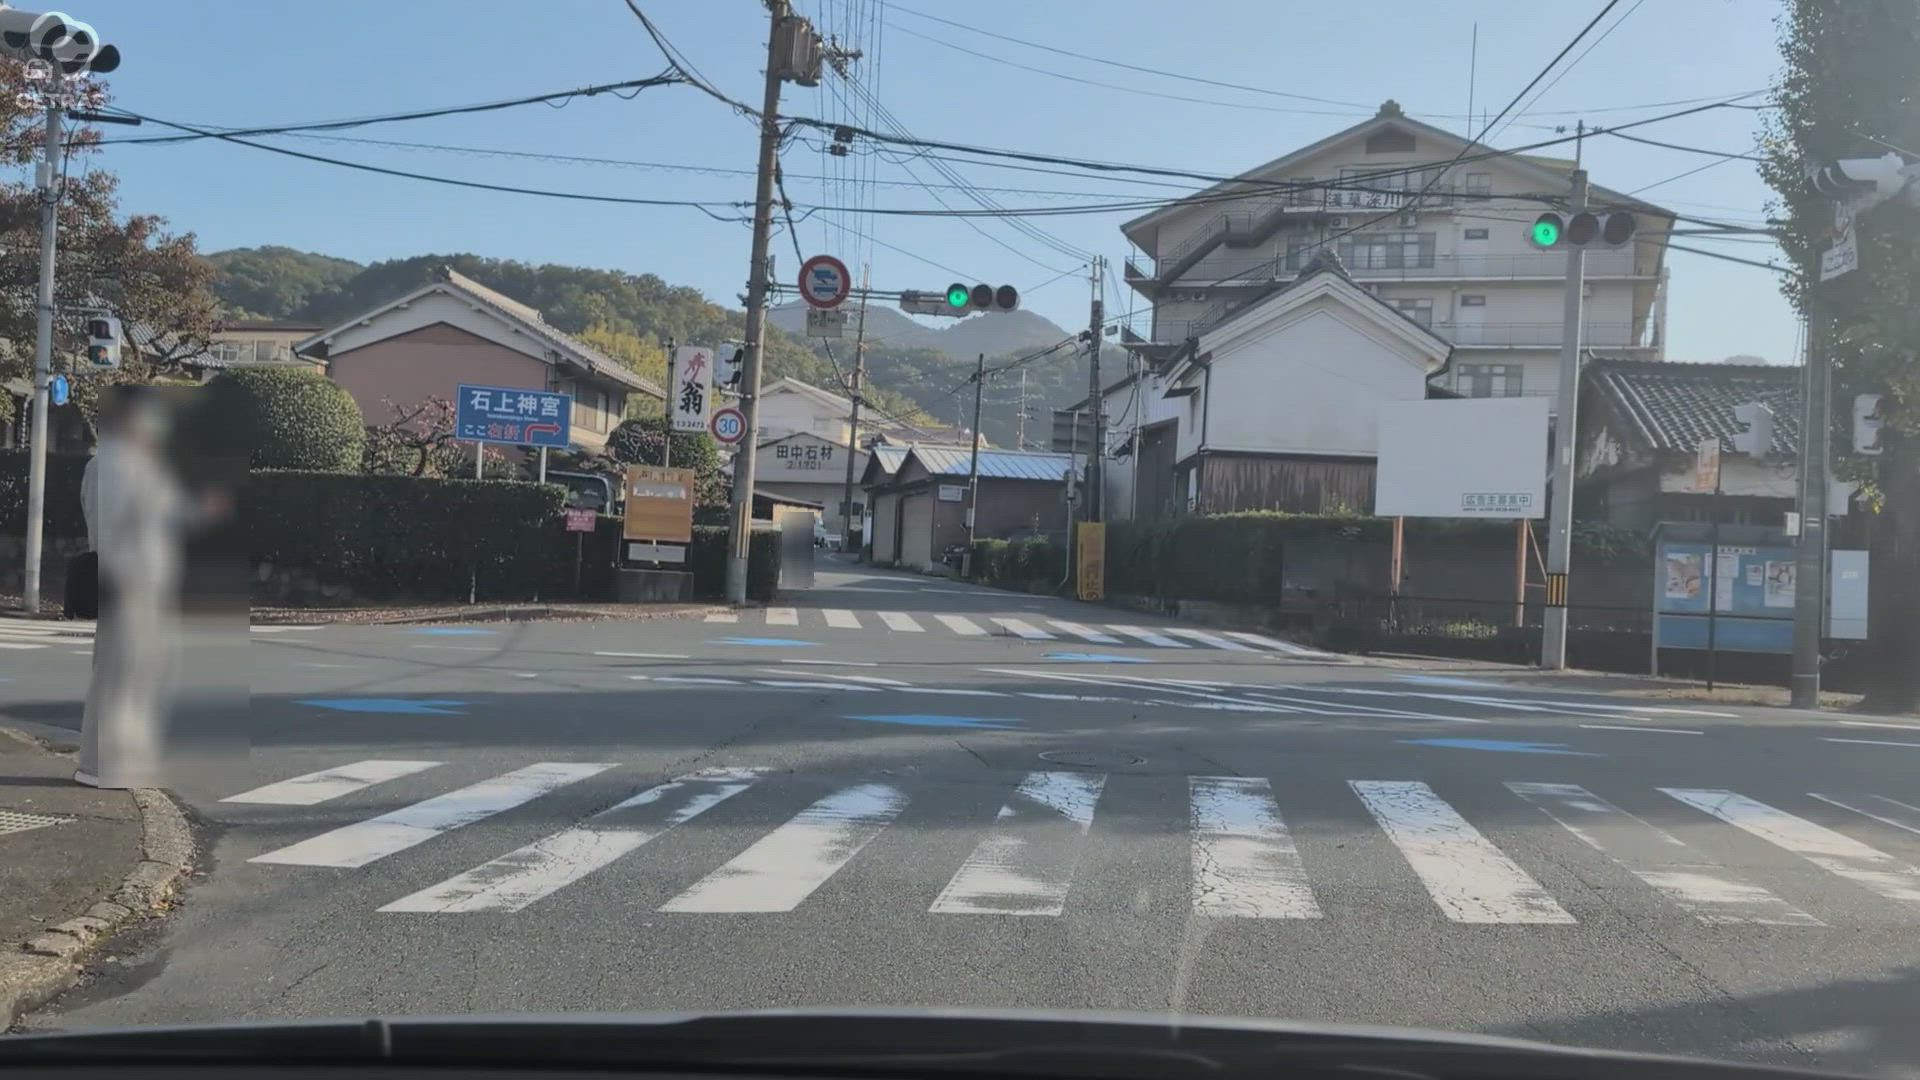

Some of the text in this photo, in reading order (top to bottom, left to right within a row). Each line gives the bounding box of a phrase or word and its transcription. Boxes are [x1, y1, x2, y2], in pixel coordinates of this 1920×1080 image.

[470, 390, 560, 417] 石上神宮
[465, 423, 520, 440] ここ右折
[719, 418, 738, 434] 30
[777, 445, 833, 461] 田中石材
